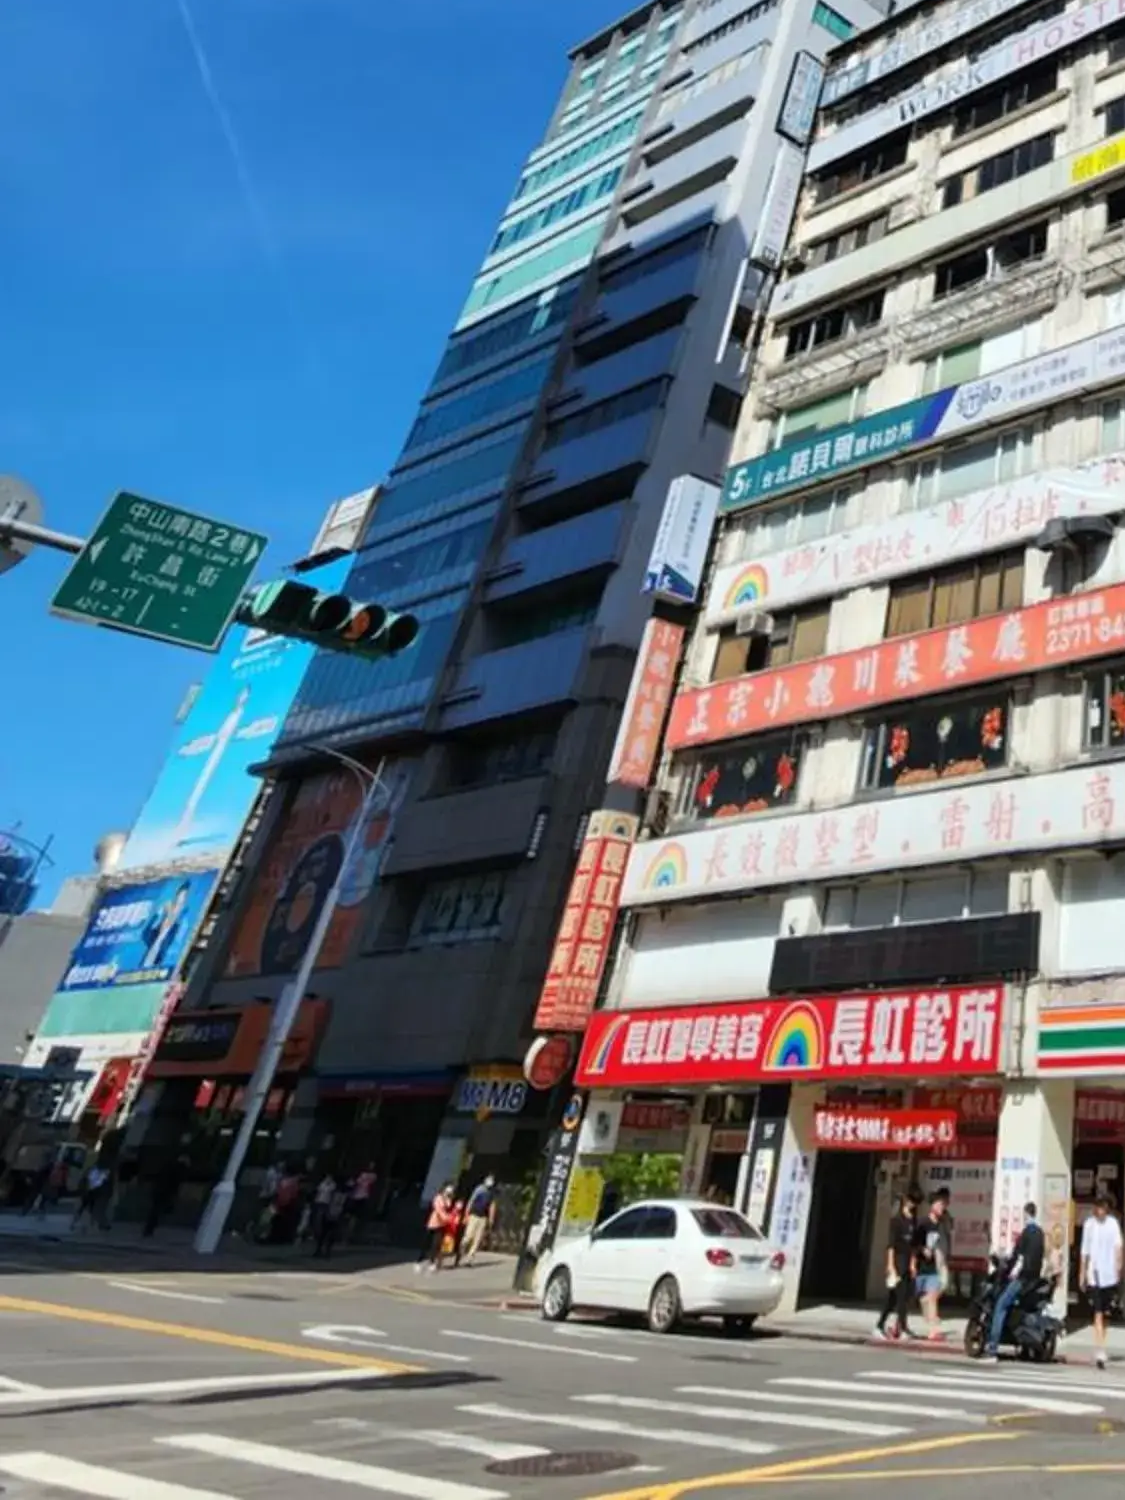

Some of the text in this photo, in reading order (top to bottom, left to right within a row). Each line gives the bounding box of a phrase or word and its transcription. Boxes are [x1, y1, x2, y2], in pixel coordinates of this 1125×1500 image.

[898, 64, 985, 123] WORK
[620, 1011, 766, 1066] 長虹醫學美容
[828, 988, 999, 1066] 長虹診所
